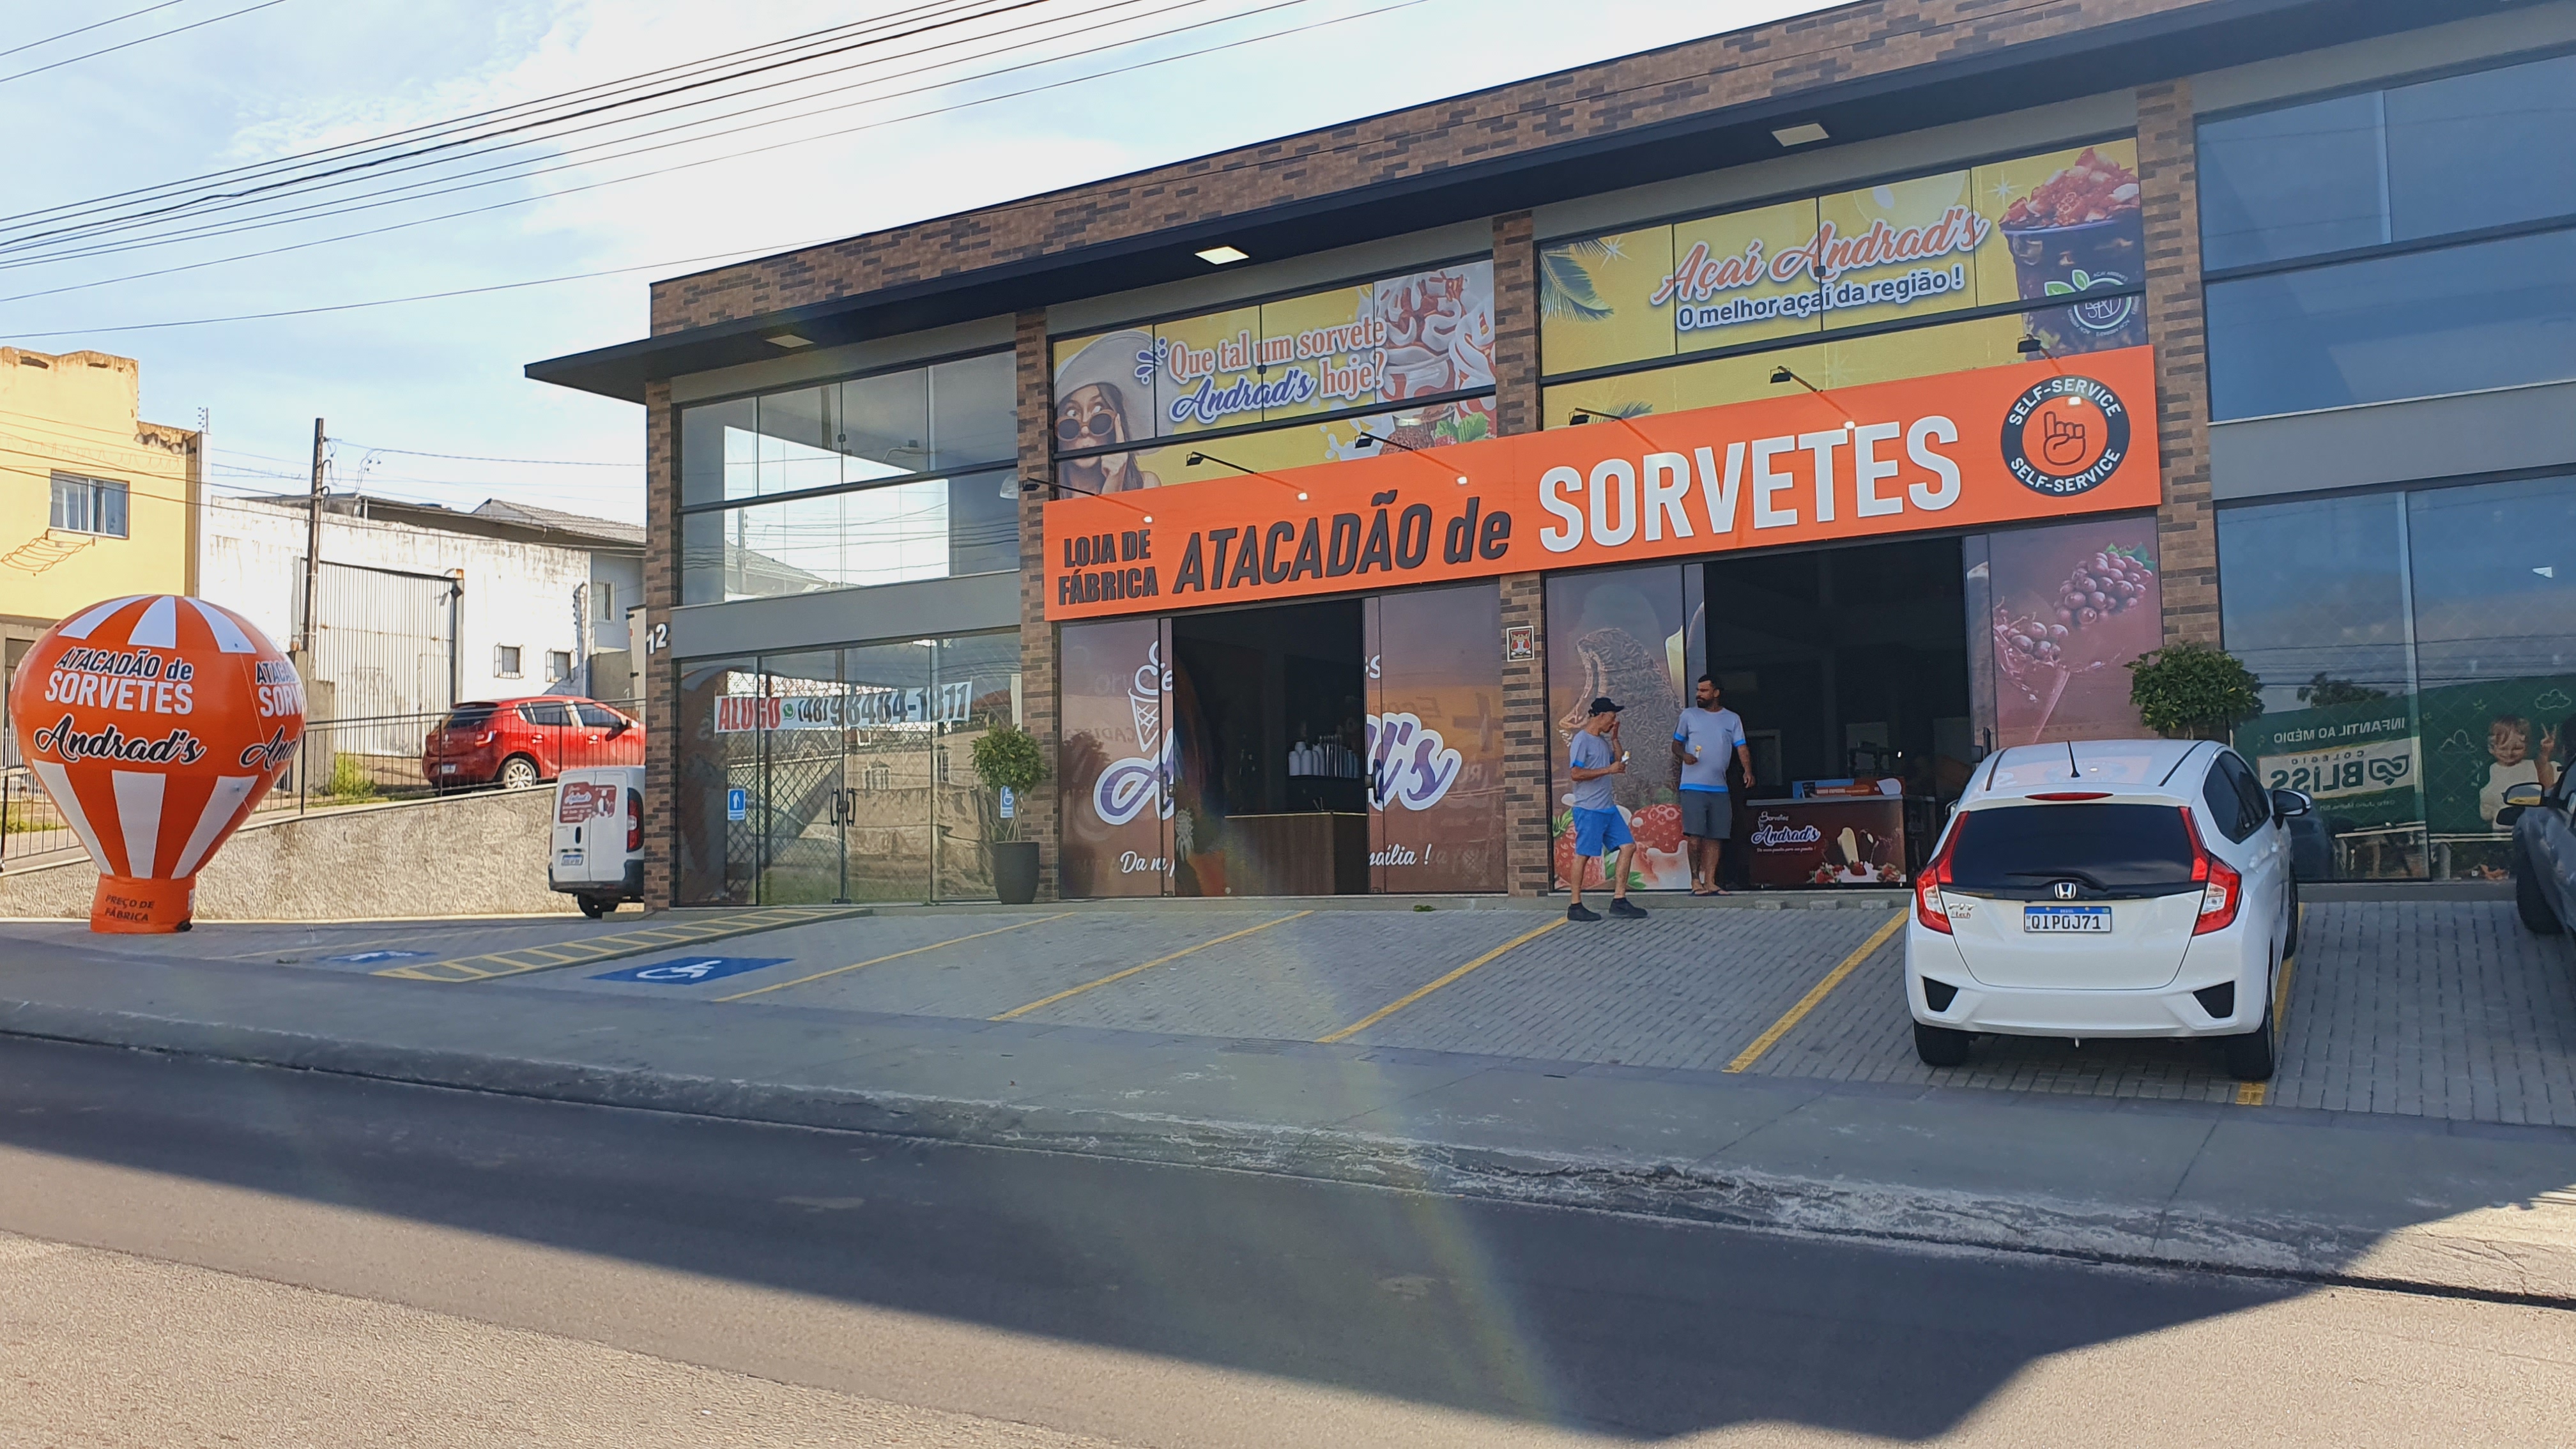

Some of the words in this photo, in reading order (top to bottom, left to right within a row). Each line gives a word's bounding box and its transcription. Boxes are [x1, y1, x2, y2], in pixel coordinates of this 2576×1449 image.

[1652, 237, 1765, 302] Açaí
[1771, 208, 1988, 280] Andrad's
[1679, 307, 1694, 327] O
[1699, 298, 1778, 325] melhor
[1782, 286, 1831, 314] açaí
[1836, 284, 1865, 303] da
[1170, 344, 1213, 381] Que
[1220, 333, 1250, 369] tal
[1255, 337, 1292, 364] um
[1299, 317, 1384, 356] sorvete
[1172, 369, 1315, 420] Andrad's
[1322, 350, 1385, 397] hoje?
[2008, 378, 2122, 426] SELF-SERVICE
[1539, 415, 1961, 554] SORVETES
[2011, 448, 2121, 493] SELF-SERVICE
[1064, 533, 1117, 569] LOJA
[1121, 528, 1151, 562] DE
[1171, 489, 1433, 594] ATACADÃO
[1443, 496, 1512, 565] de
[1058, 565, 1160, 606] FÁBRICA
[646, 623, 667, 655] 12
[55, 647, 161, 678] ATACADÃO
[165, 657, 193, 680] de
[45, 670, 194, 715] SORVETES
[717, 696, 781, 730] ALUGO
[34, 714, 206, 763] Andrad's
[1752, 825, 1820, 845] Andrad's
[104, 906, 149, 921] FÁBRICA
[105, 894, 137, 909] PREÇO
[139, 900, 155, 909] DE
[2031, 915, 2101, 930] QIP0J71
